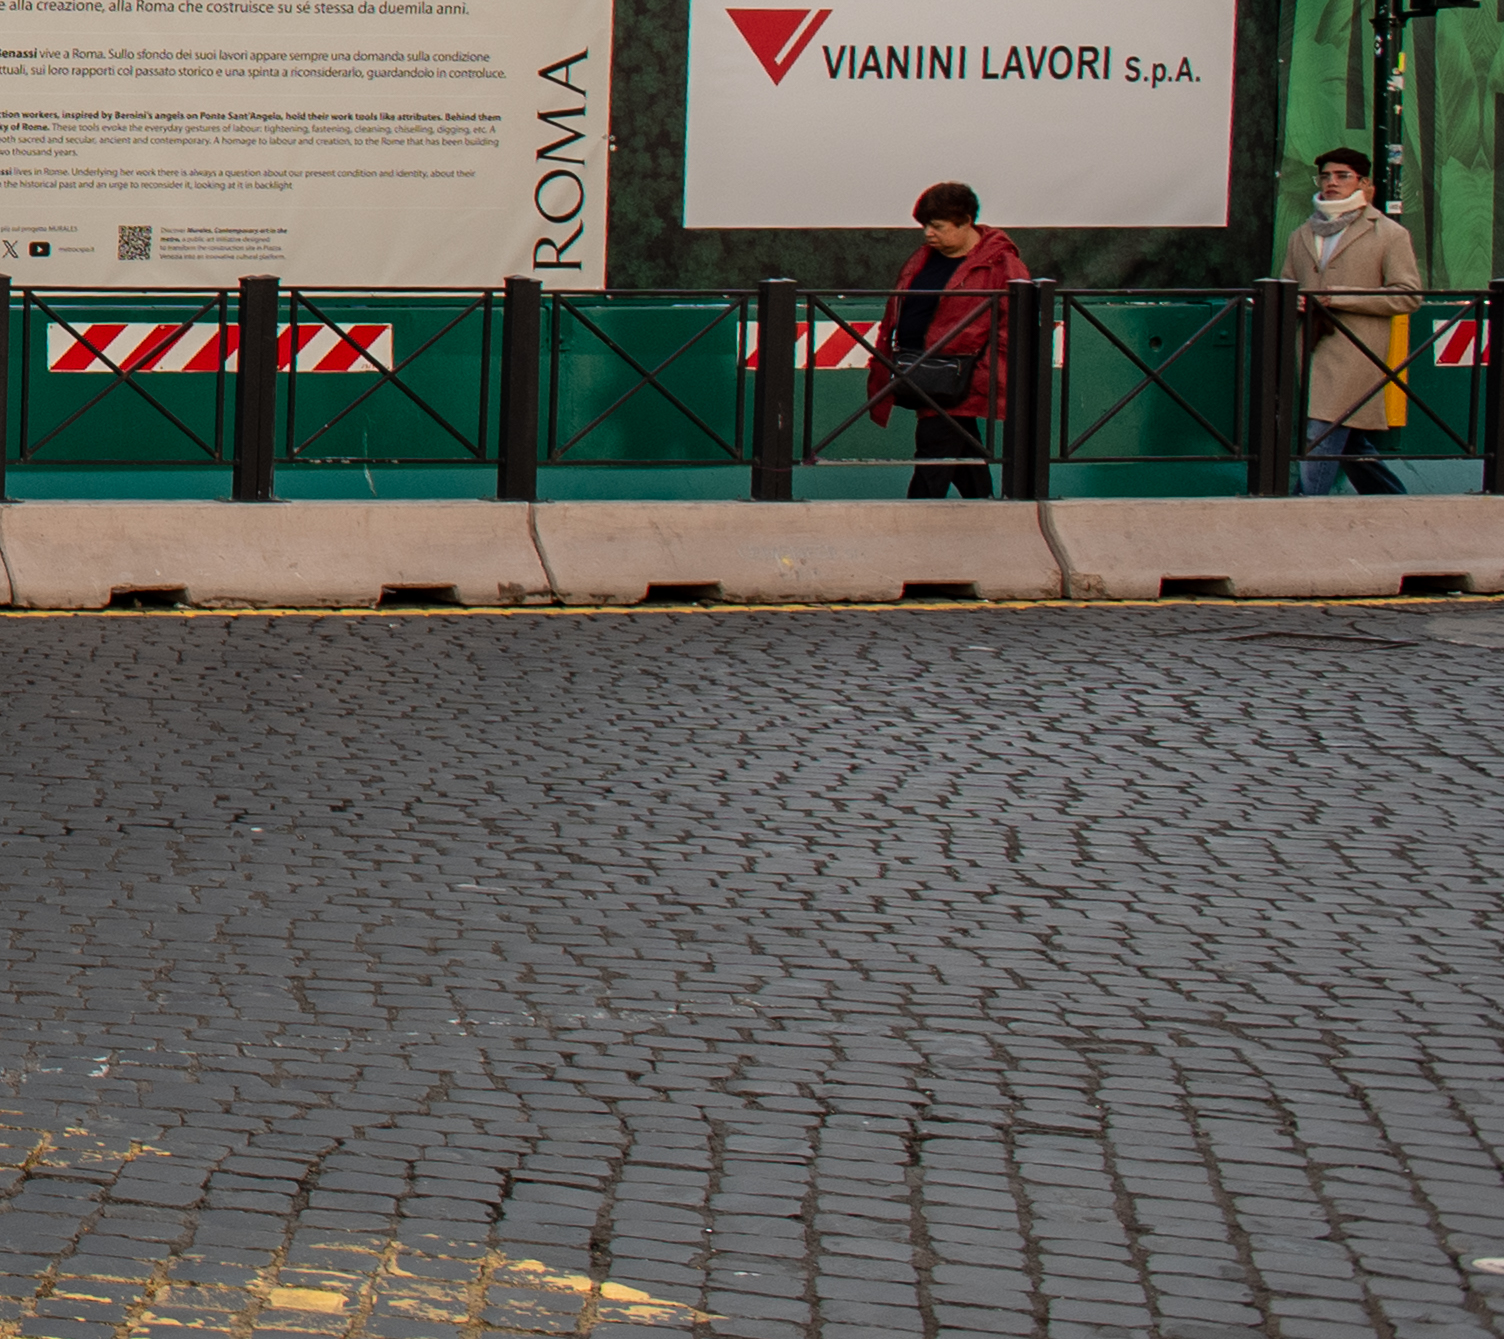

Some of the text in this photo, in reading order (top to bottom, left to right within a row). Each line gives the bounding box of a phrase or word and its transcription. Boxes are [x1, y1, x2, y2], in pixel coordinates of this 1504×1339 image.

[822, 45, 1202, 89] VIANINI LAVORI S.p.A.
[532, 46, 589, 271] ROMA
